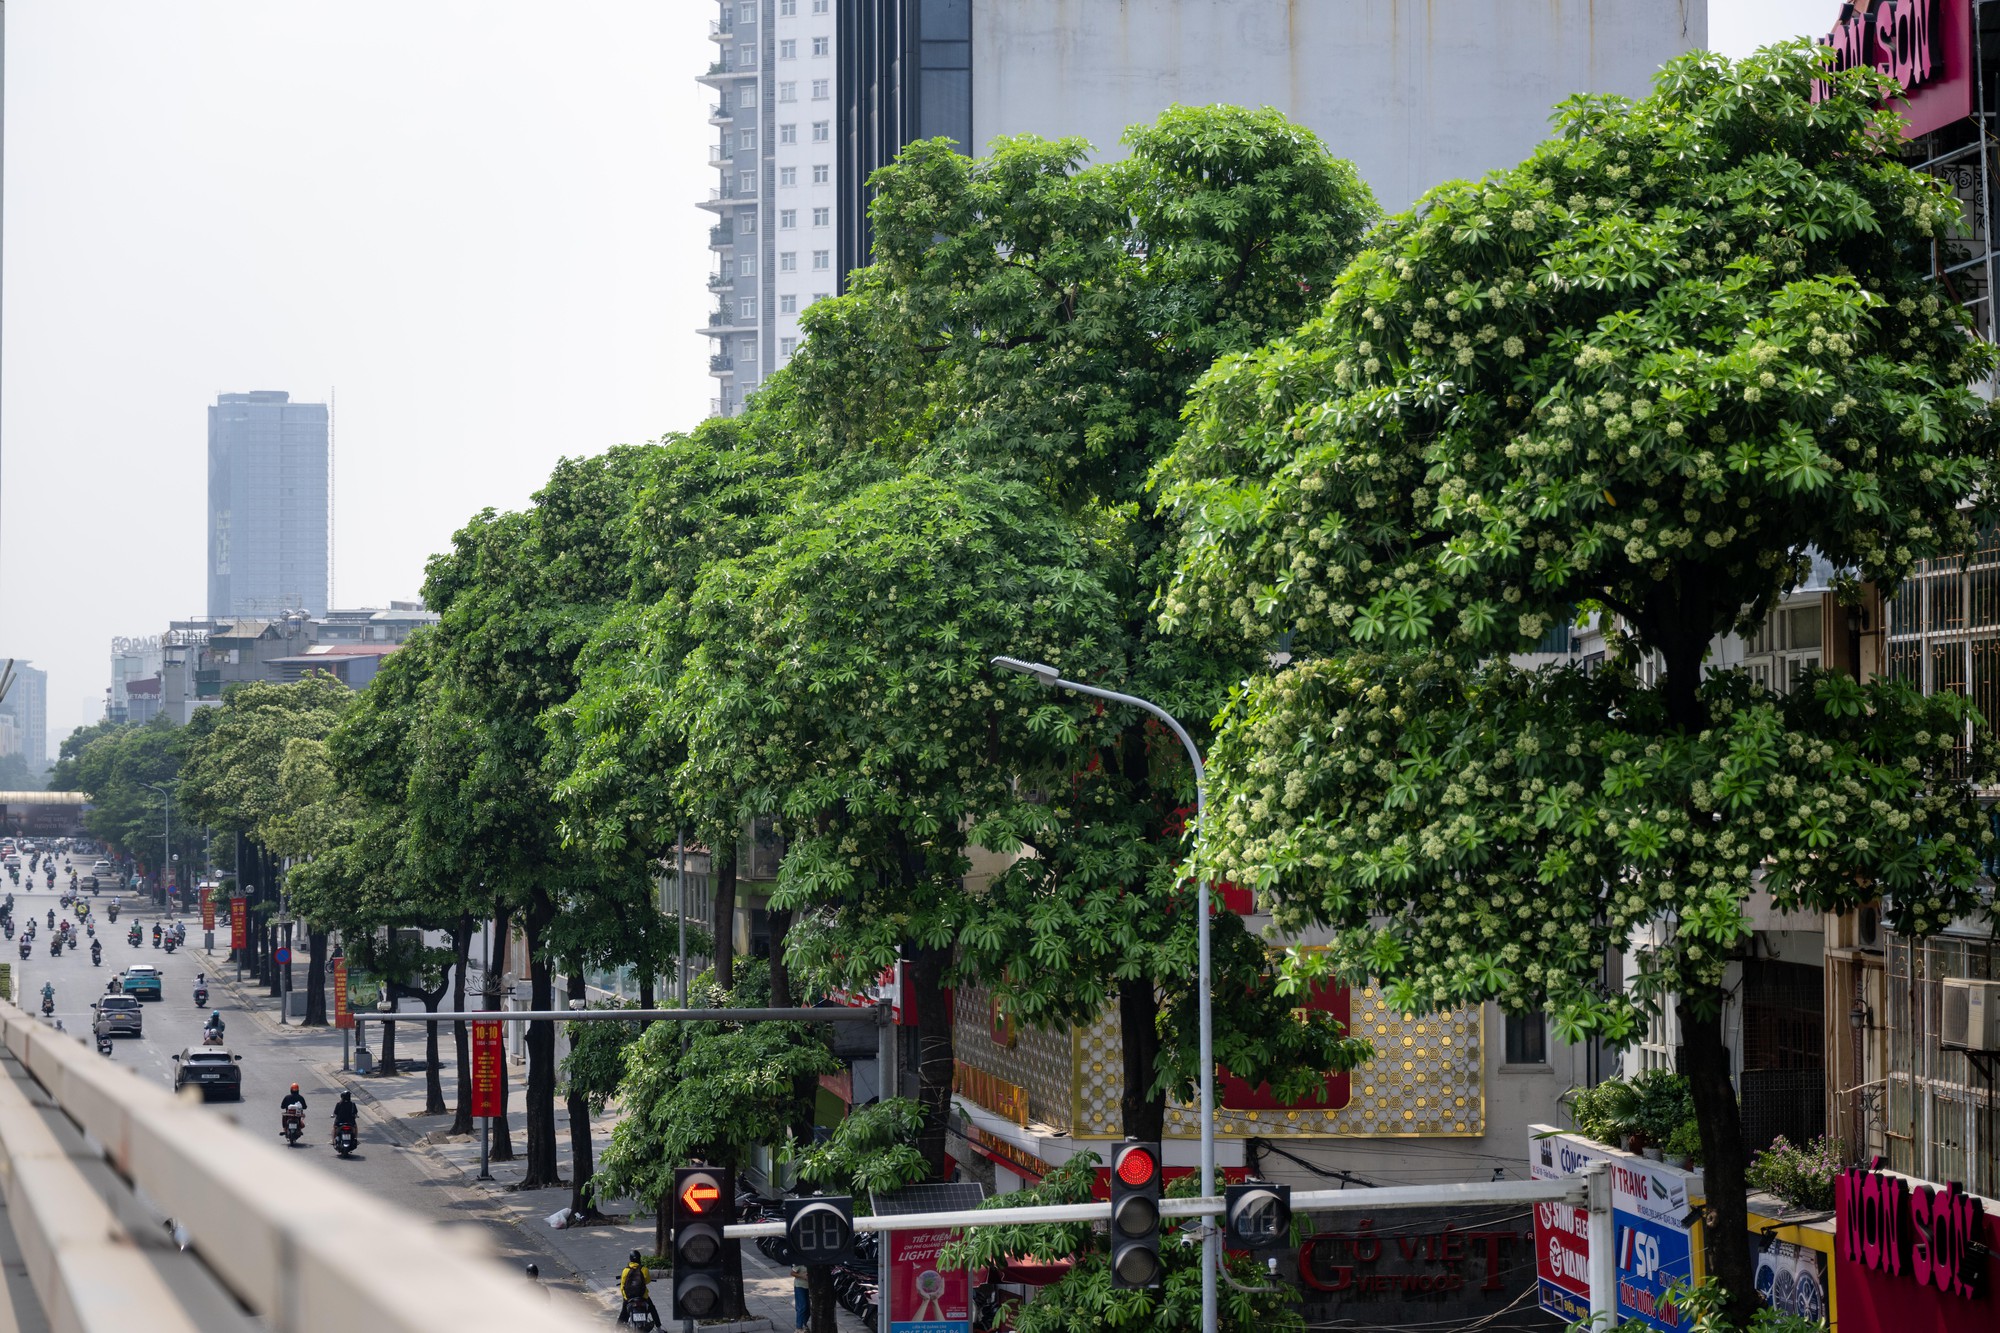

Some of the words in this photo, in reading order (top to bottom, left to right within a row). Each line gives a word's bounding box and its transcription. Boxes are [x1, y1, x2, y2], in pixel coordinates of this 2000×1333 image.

[1560, 1144, 1582, 1174] CÔNG
[1617, 1167, 1648, 1201] TRANG
[1844, 1154, 1902, 1277] NÓN
[898, 1249, 934, 1261] LIGHT
[1298, 1218, 1382, 1292] GỖ
[1356, 1273, 1466, 1293] VIETWOOD
[1620, 1274, 1636, 1310] ỐNG
[1636, 1286, 1657, 1319] NƯỚC
